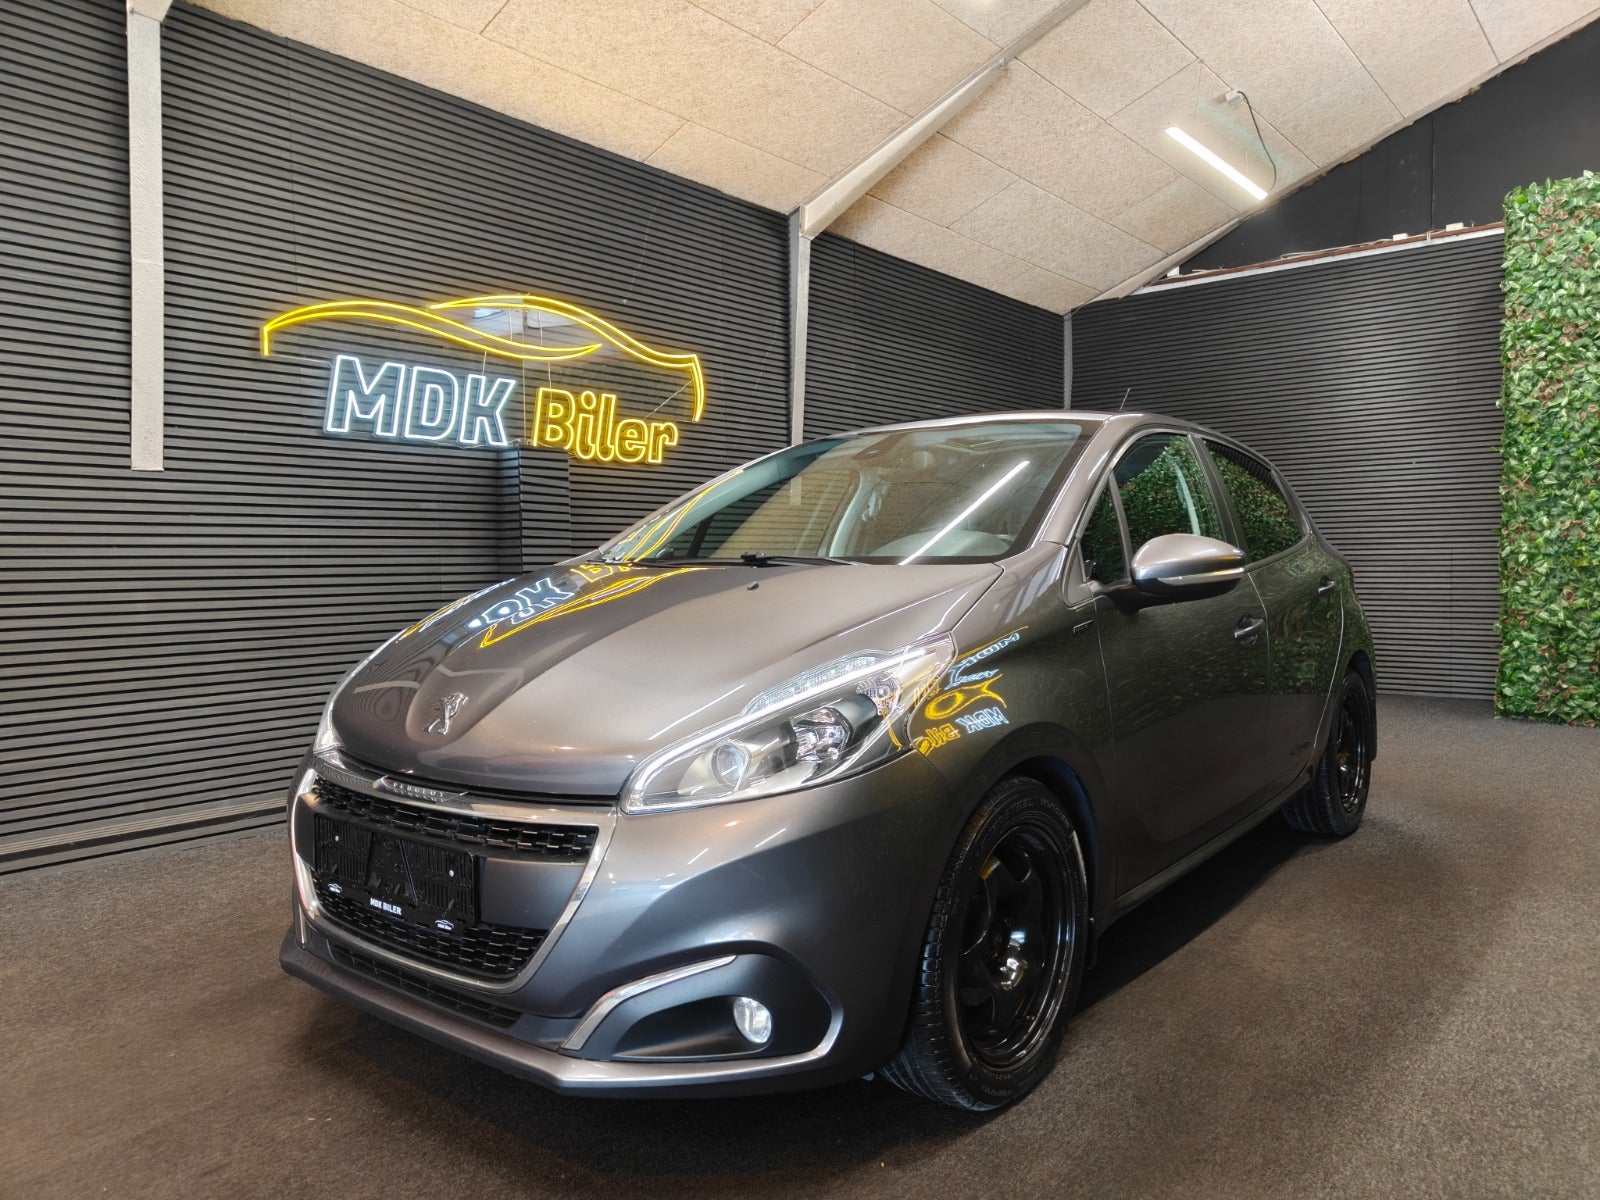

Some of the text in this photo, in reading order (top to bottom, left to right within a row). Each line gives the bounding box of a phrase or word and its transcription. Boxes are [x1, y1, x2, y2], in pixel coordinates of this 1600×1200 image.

[324, 354, 679, 464] MDK Biler
[383, 902, 402, 916] BILER
